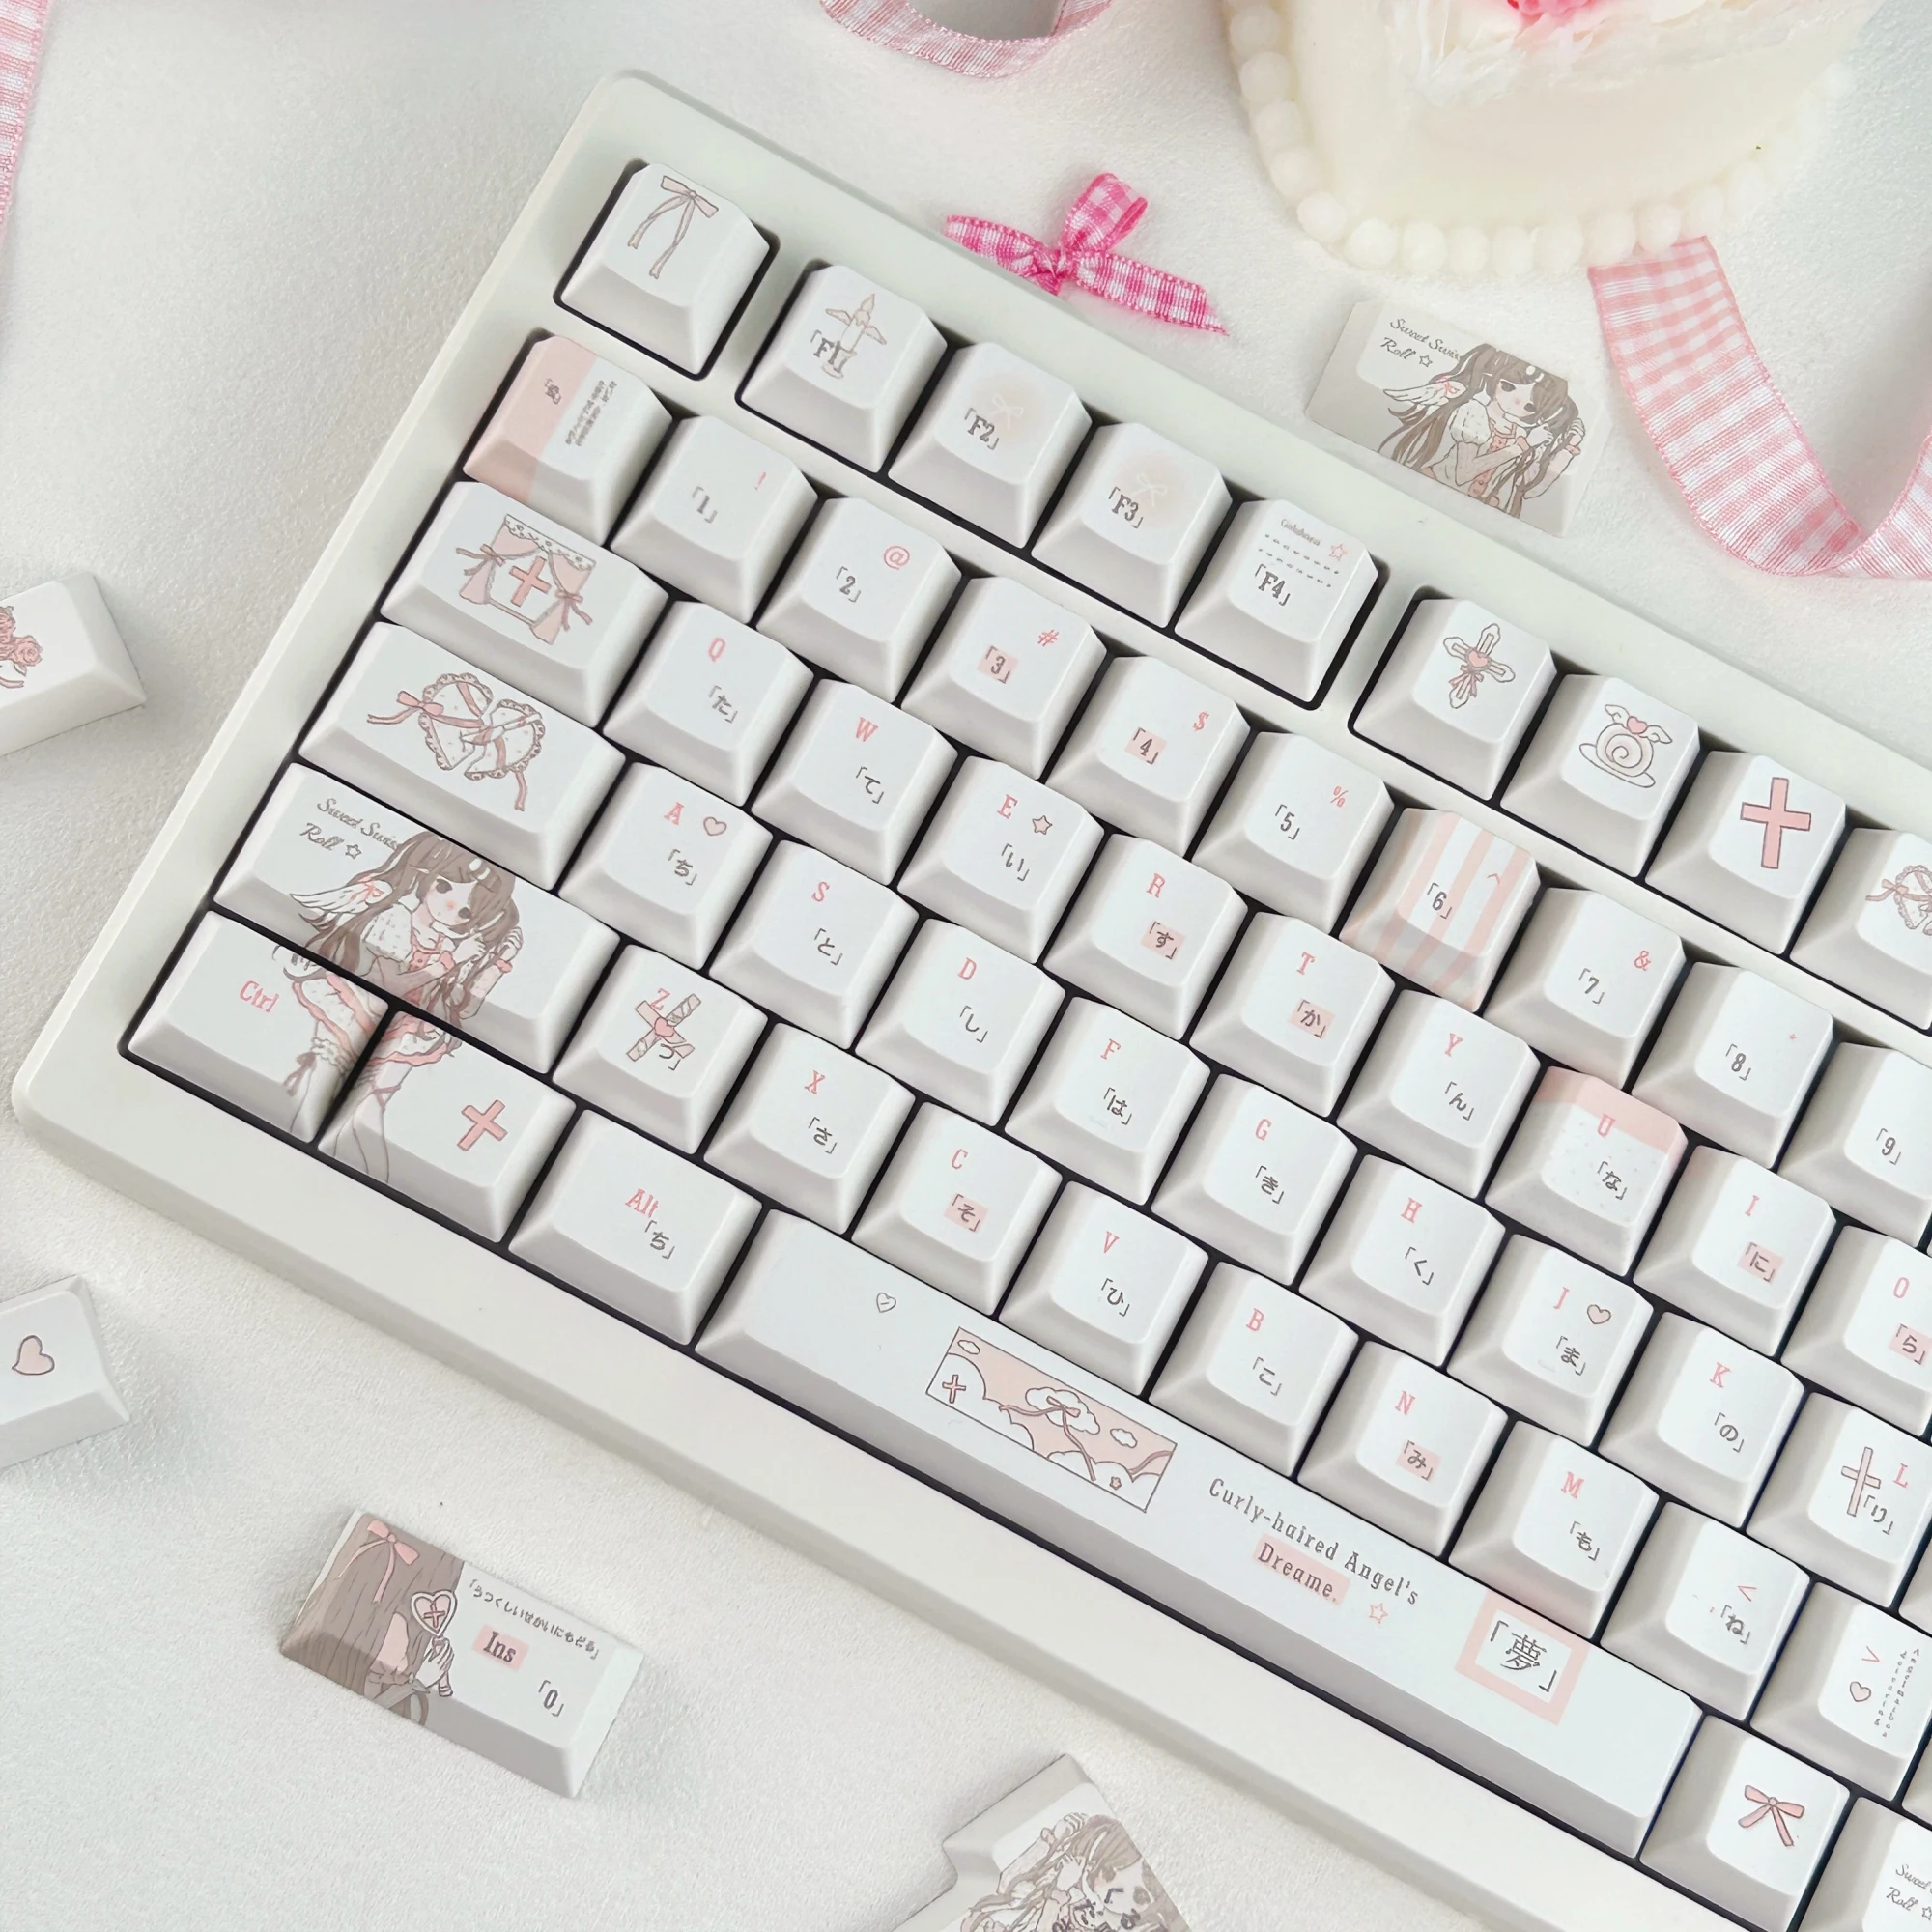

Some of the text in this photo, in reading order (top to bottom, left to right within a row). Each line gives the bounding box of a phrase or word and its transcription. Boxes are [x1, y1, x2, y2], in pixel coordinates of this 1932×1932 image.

[1389, 318, 1427, 344] Sweet
[1379, 337, 1416, 361] Roll
[965, 408, 999, 450] 「F2」
[754, 472, 766, 490] !
[693, 487, 717, 523] 「1」
[1109, 487, 1143, 528] 「F3」
[883, 546, 910, 570] @
[836, 566, 861, 603] 「2」
[1255, 563, 1291, 607] 「F4」
[708, 638, 725, 662] Q
[1037, 630, 1059, 647] #
[985, 646, 1010, 684] 「3」
[710, 686, 737, 723] 「た」
[1193, 712, 1209, 731] $
[856, 717, 878, 742] W
[1133, 727, 1158, 764] 「4」
[856, 767, 884, 804] 「て」
[1331, 786, 1348, 807] %
[664, 801, 685, 826] A
[997, 794, 1018, 819] E
[1275, 805, 1299, 840] 「5」
[299, 823, 344, 854] Roll
[667, 848, 697, 887] 「ち」
[1002, 843, 1029, 881] 「い」
[811, 882, 830, 902] S
[1147, 873, 1165, 898] R
[1427, 882, 1452, 920] 「6」
[814, 928, 842, 965] 「と」
[1150, 922, 1177, 959] 「す」
[958, 957, 977, 980] D
[1297, 952, 1315, 975] T
[1634, 951, 1651, 971] &
[240, 980, 279, 1012] Ctrl
[650, 987, 670, 1011] Z
[1579, 968, 1605, 1004] 「7」
[960, 1006, 988, 1043] 「し」
[1297, 1000, 1326, 1038] 「か」
[1101, 1038, 1121, 1060] F
[1445, 1033, 1463, 1057] Y
[1726, 1044, 1751, 1081] 「8」
[805, 1070, 825, 1094] X
[1104, 1088, 1132, 1125] 「は」
[1445, 1081, 1474, 1121] 「ん」
[809, 1117, 837, 1154] 「さ」
[1256, 1119, 1271, 1141] G
[1597, 1113, 1615, 1137] U
[952, 1149, 968, 1169] C
[1876, 1128, 1901, 1165] 「9」
[1256, 1166, 1284, 1204] 「き」
[1598, 1161, 1627, 1200] 「な」
[625, 1188, 659, 1218] Alt
[952, 1194, 980, 1232] 「そ」
[1401, 1198, 1422, 1223] H
[1745, 1195, 1759, 1216] I
[644, 1219, 675, 1260] 「ち」
[1104, 1231, 1120, 1253] V
[1405, 1247, 1434, 1285] 「く」
[1746, 1242, 1776, 1283] 「に」
[1101, 1278, 1129, 1317] 「ひ」
[1553, 1287, 1570, 1309] J
[1893, 1277, 1909, 1298] O
[1246, 1308, 1264, 1331] B
[1556, 1336, 1585, 1376] 「ま」
[1253, 1357, 1282, 1396] 「こ」
[1710, 1362, 1730, 1388] K
[1395, 1391, 1415, 1415] N
[1715, 1412, 1744, 1453] 「の」
[1404, 1440, 1433, 1481] 「み」
[1892, 1463, 1909, 1489] L
[1561, 1472, 1584, 1499] M
[1863, 1494, 1893, 1535] 「り」
[1209, 1478, 1418, 1605] Curly-haired Angel's
[1570, 1521, 1600, 1561] 「も」
[483, 1631, 517, 1664] Ins
[1490, 1620, 1558, 1693] 「夢」
[539, 1680, 564, 1717] 「0」
[1886, 1887, 1918, 1911] Roll
